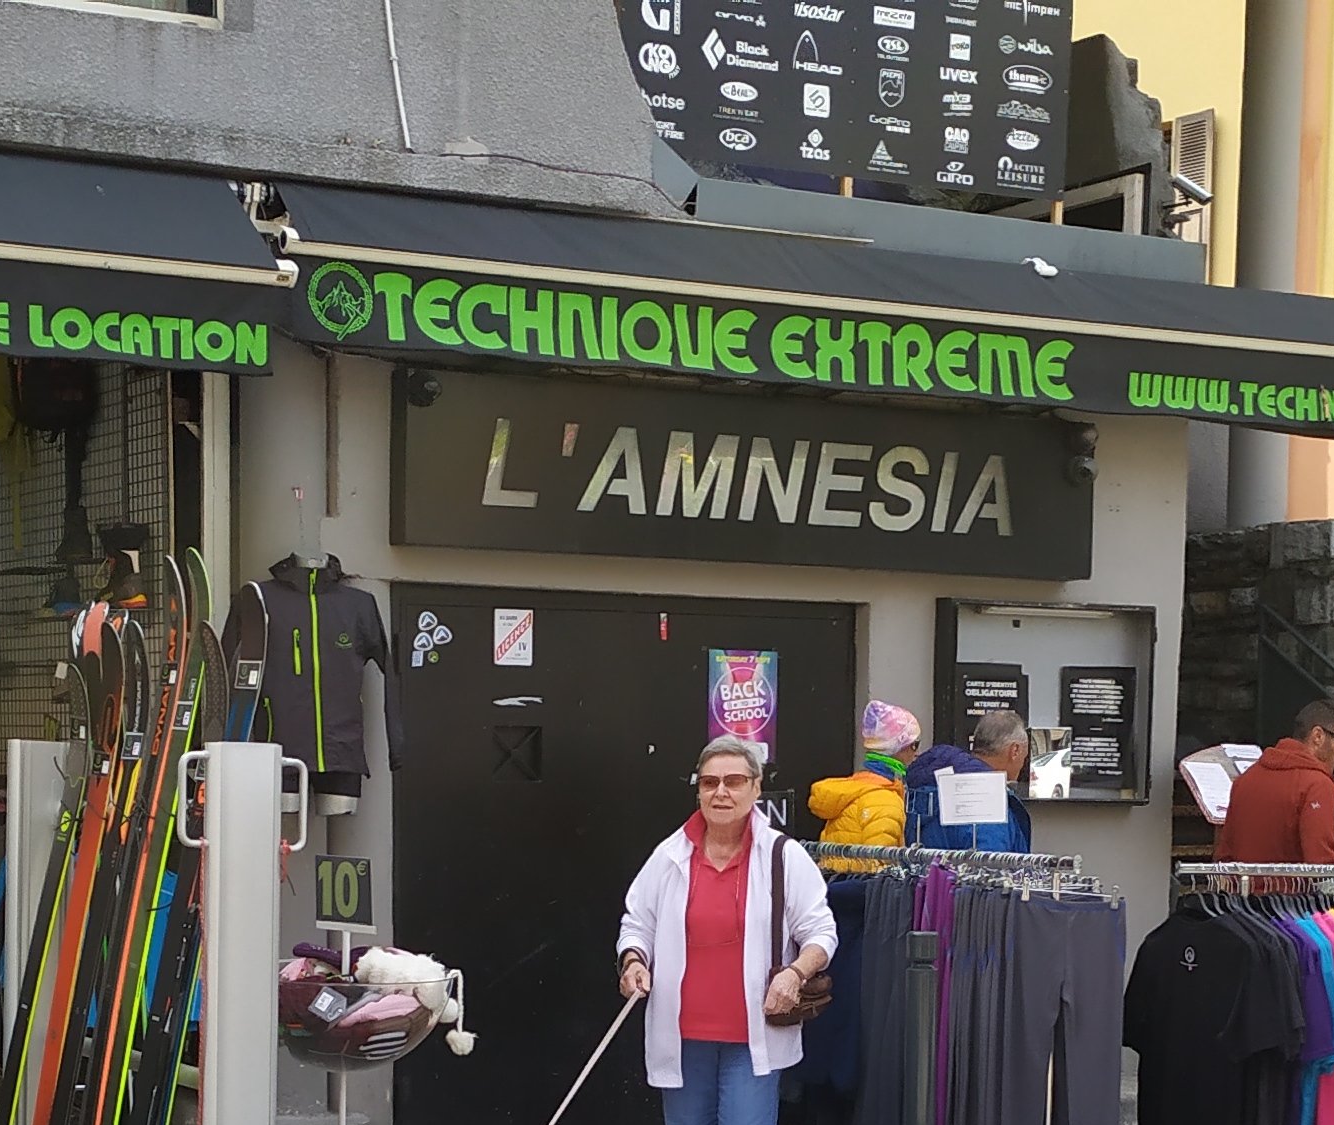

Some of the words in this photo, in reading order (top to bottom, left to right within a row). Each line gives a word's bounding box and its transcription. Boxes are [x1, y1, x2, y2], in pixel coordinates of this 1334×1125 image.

[735, 40, 770, 57] Black
[726, 53, 779, 72] Diamond
[795, 60, 843, 76] HEAD
[939, 66, 979, 85] uvex
[869, 114, 912, 128] GoPro
[725, 129, 750, 144] bca
[936, 171, 974, 186] GIRO
[997, 170, 1046, 185] LEISURE
[29, 306, 268, 366] LOCATION
[373, 272, 758, 373] TECHNIQUE
[771, 314, 1075, 400] EXTREME
[482, 416, 1015, 536] L'AMNESIA
[496, 612, 532, 660] LICENCE
[720, 680, 766, 700] BACK
[965, 688, 1018, 698] OBLIGATOIRE
[723, 707, 769, 722] SCHOOL
